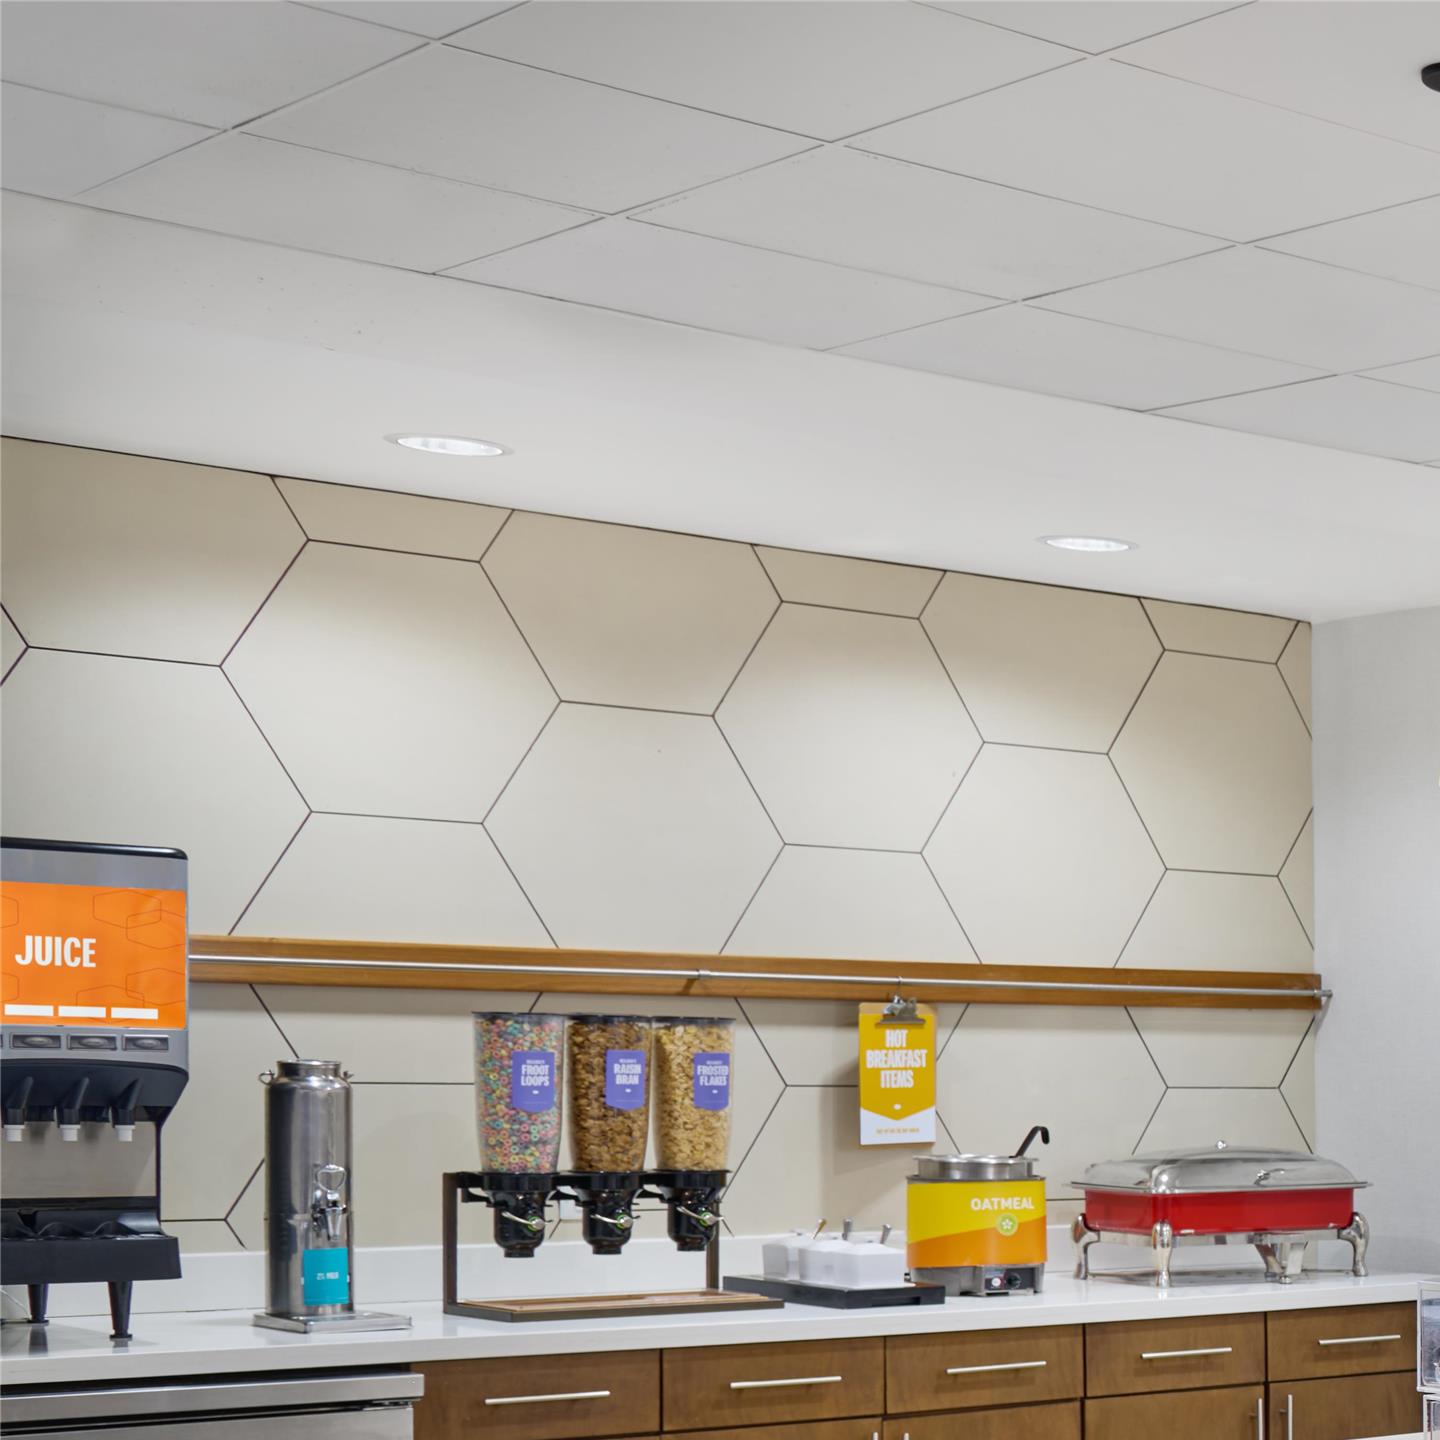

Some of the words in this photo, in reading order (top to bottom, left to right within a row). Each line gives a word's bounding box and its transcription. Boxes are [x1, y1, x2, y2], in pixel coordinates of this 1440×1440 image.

[15, 935, 97, 968] JUICE
[885, 1029, 908, 1048] HOT
[866, 1049, 927, 1069] BREAKFAST
[521, 1075, 550, 1087] LOOPS
[880, 1069, 914, 1088] ITEMS
[970, 1196, 1035, 1212] OATMEAL
